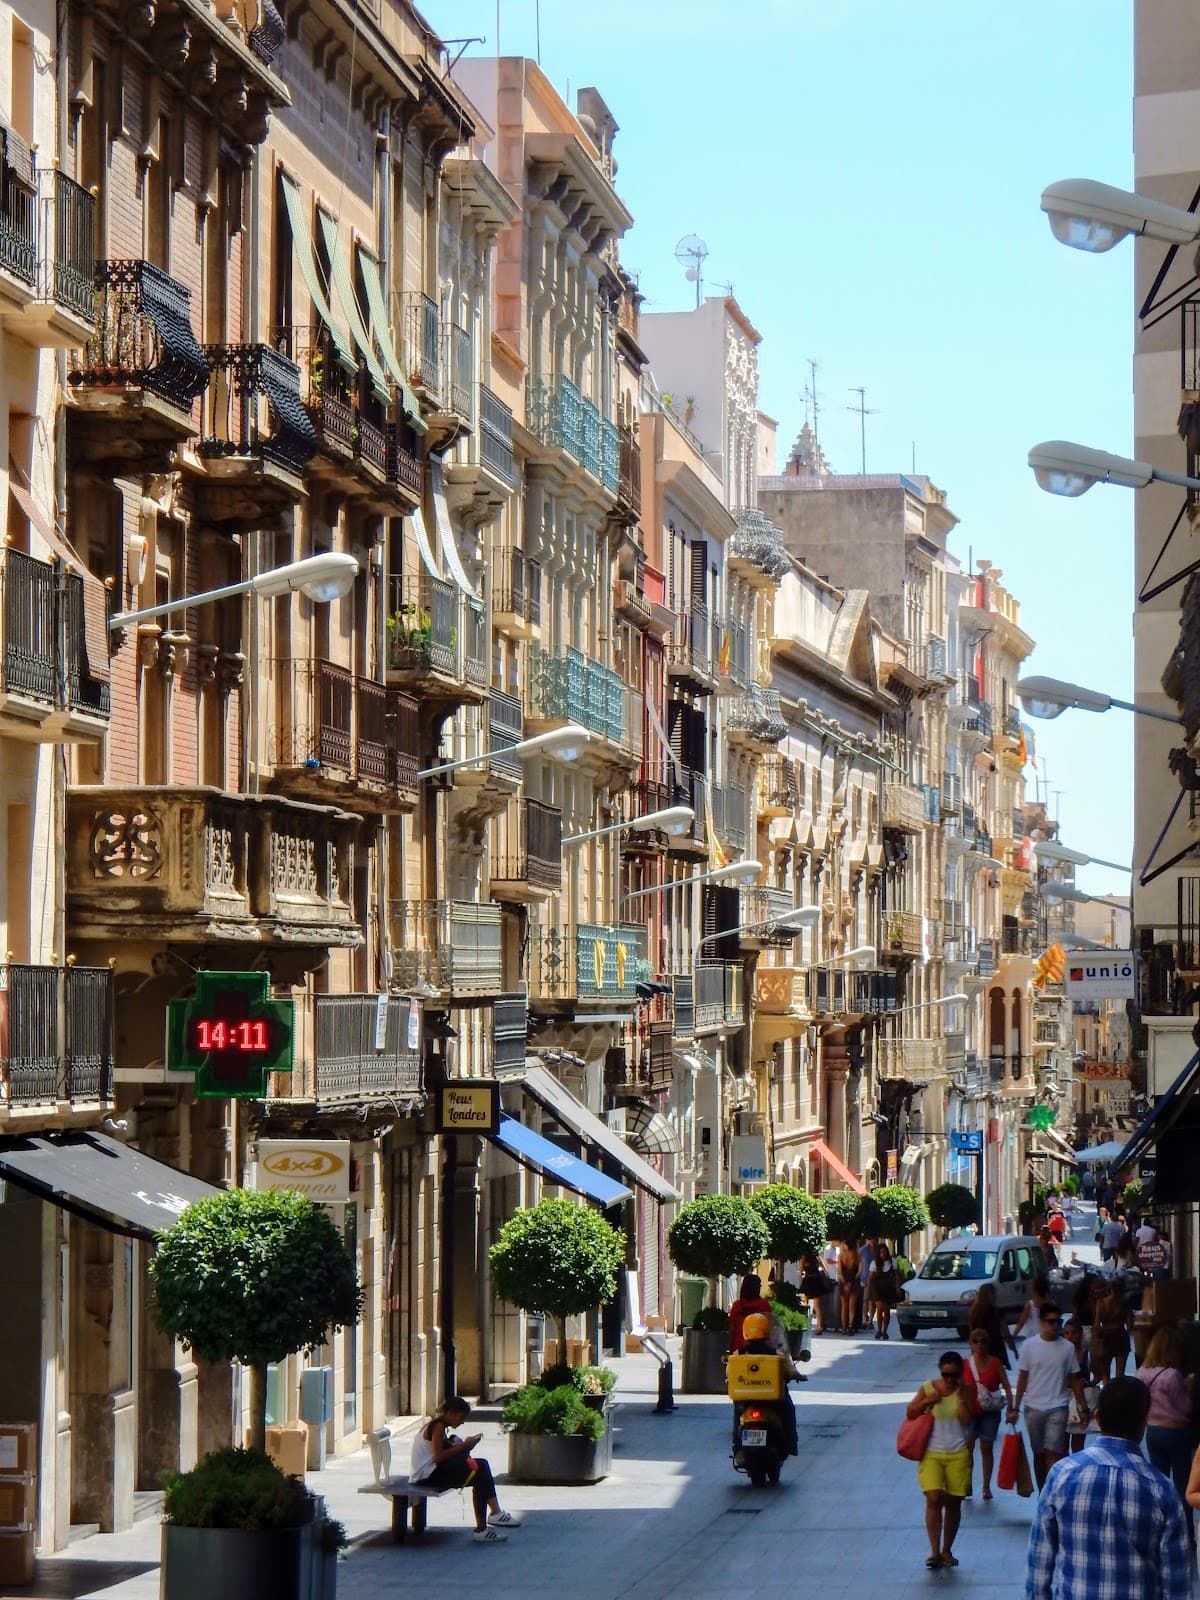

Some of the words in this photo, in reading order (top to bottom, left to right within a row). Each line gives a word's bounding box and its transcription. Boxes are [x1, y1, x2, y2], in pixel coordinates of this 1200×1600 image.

[1086, 963, 1132, 976] unió
[197, 1021, 266, 1049] 14:11
[449, 1091, 472, 1105] Reus
[449, 1107, 486, 1124] Londres
[271, 1157, 324, 1171] 4x4
